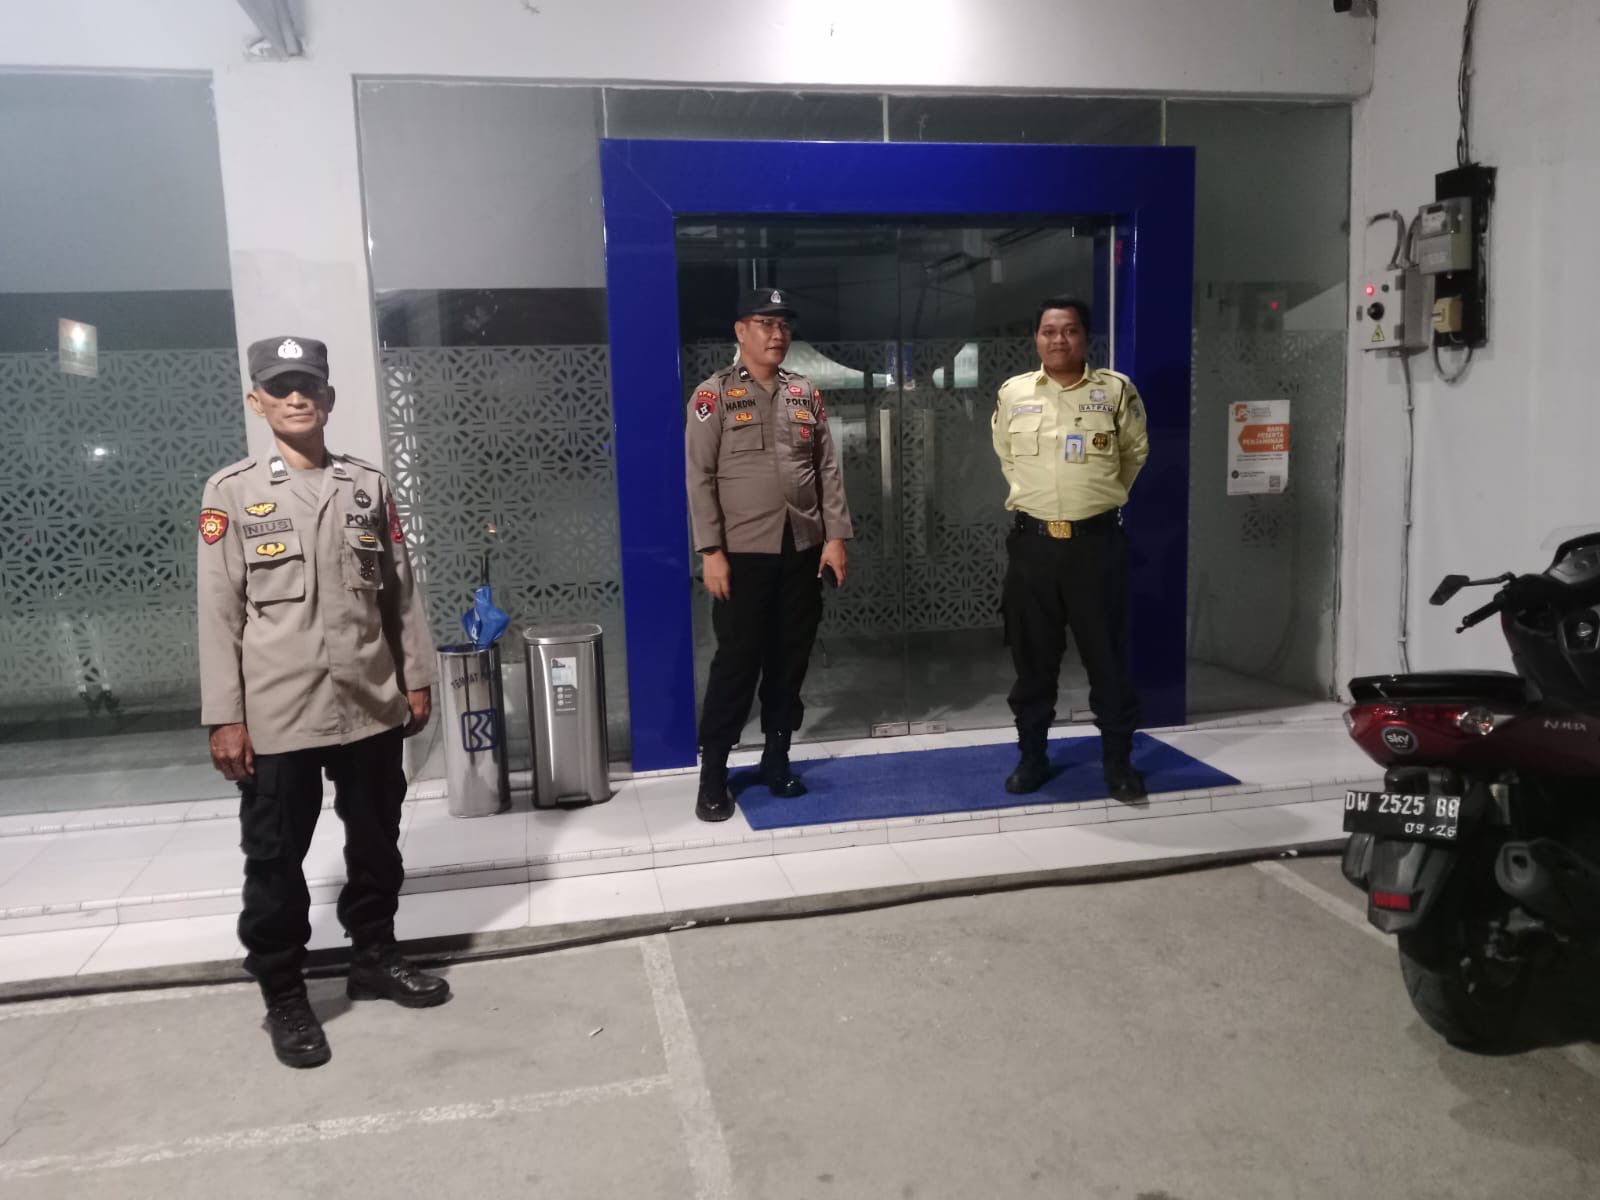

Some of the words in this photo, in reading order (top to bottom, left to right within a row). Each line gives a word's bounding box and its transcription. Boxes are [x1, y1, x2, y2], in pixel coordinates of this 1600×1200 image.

[785, 398, 810, 407] POLRI
[1080, 404, 1113, 412] SATPAM
[247, 520, 289, 535] NIUS
[1345, 791, 1370, 812] DW
[1378, 794, 1425, 816] 2525
